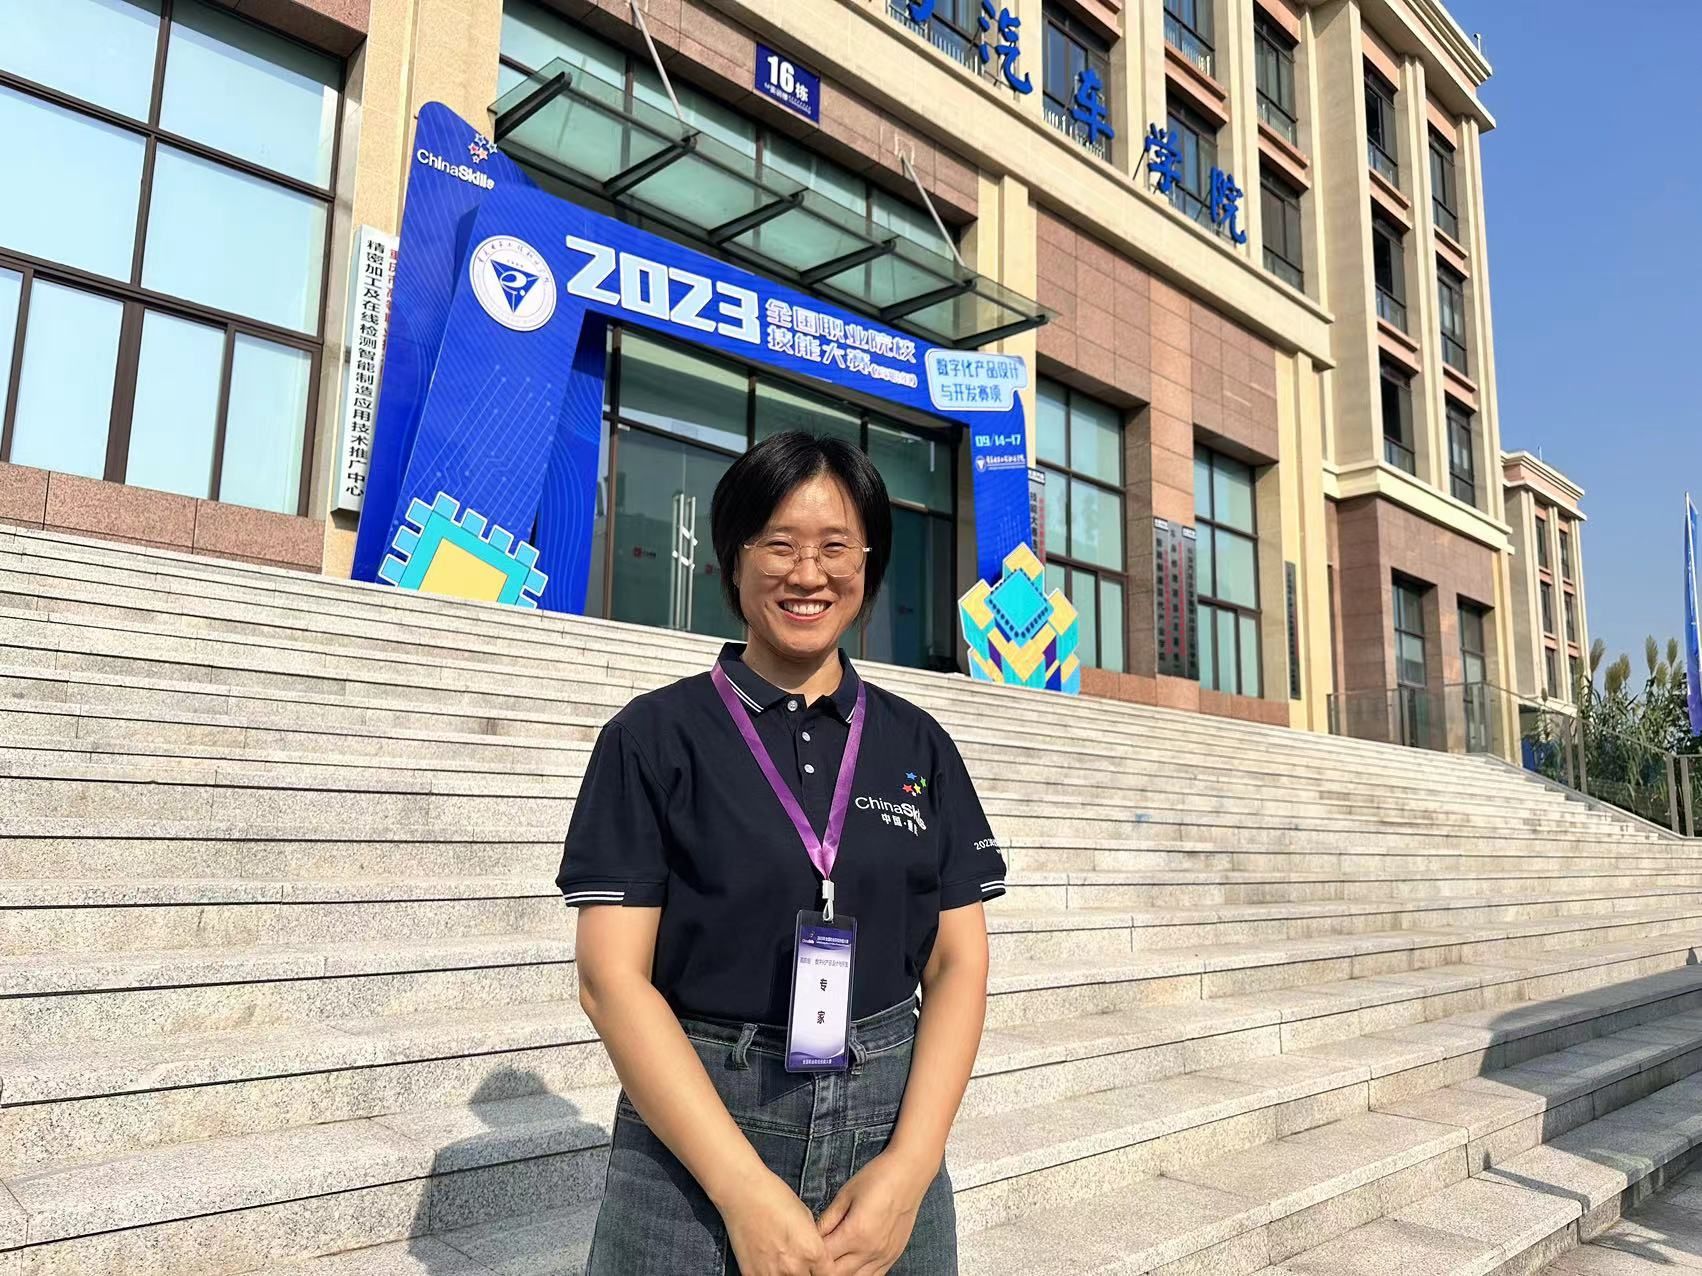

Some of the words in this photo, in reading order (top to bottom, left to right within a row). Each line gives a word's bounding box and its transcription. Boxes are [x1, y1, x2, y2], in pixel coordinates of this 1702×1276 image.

[905, 0, 1247, 245] 汽车学院
[416, 148, 495, 190] ChinaSkills
[565, 234, 761, 345] 2023
[765, 298, 917, 363] 全国职业院校
[767, 325, 871, 375] 技能大赛
[345, 239, 385, 497] 精密加工及在线检测智能制造应用技术推广中心
[935, 357, 1019, 380] 数字化产品设计
[941, 383, 1002, 403] 与开发赛项
[975, 434, 1021, 447] 09/14-17
